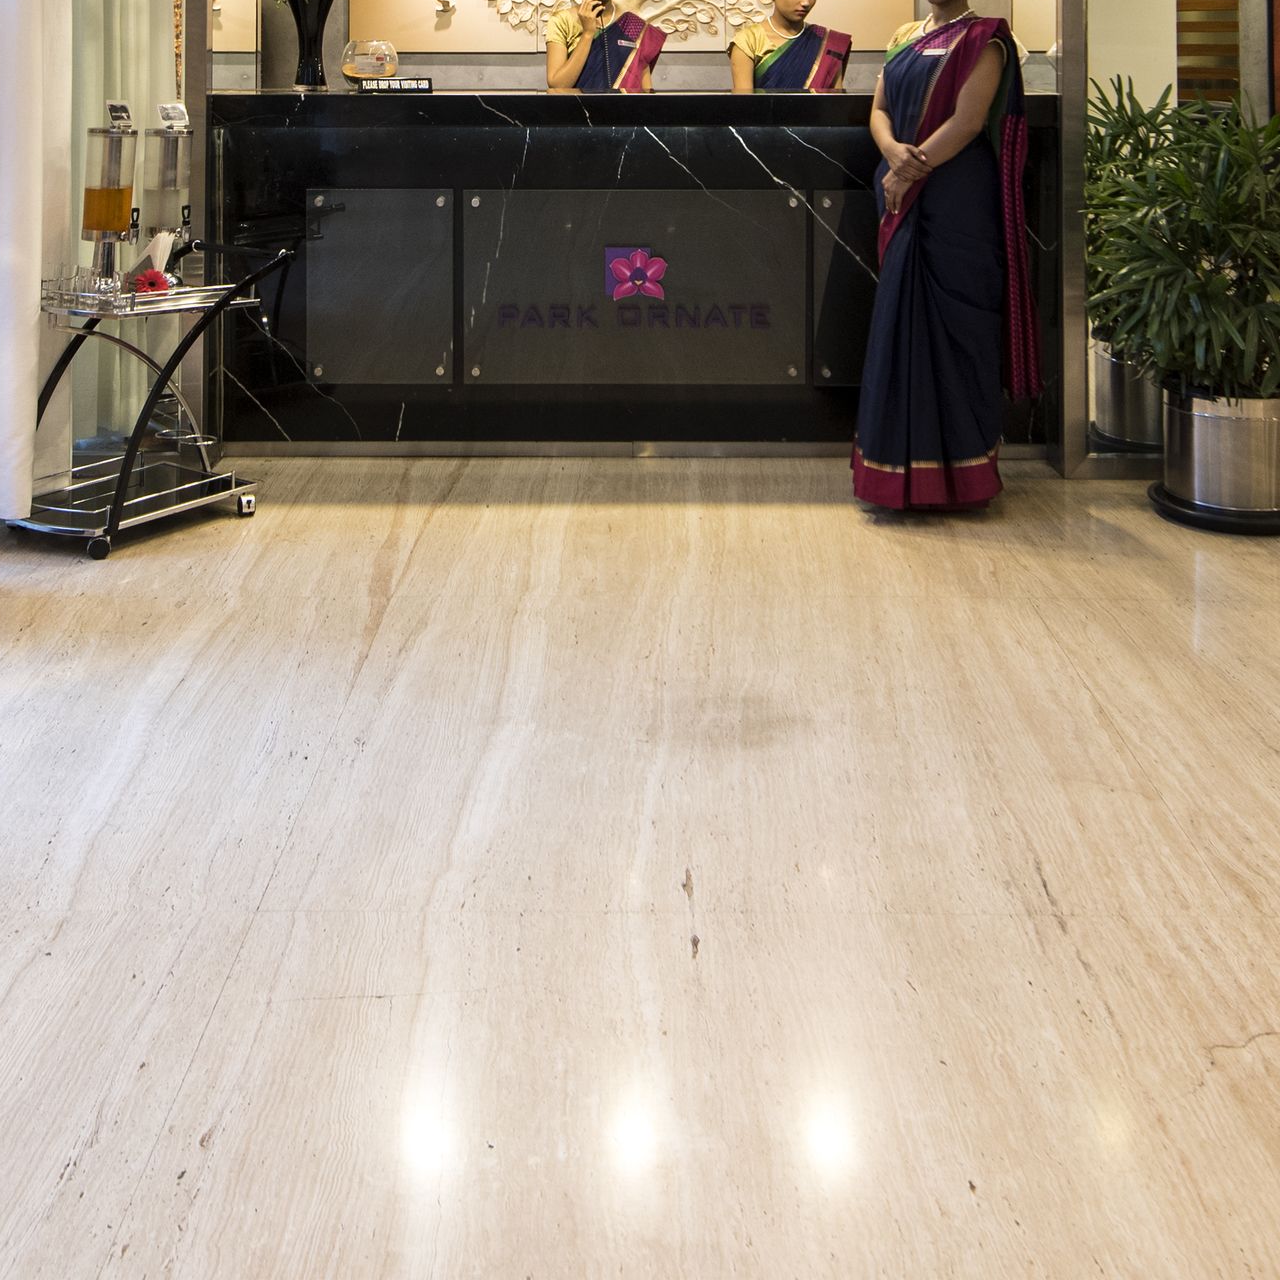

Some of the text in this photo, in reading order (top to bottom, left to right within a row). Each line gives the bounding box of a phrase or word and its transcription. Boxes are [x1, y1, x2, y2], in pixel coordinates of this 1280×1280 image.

[362, 79, 429, 89] PLEASE DROP YOUR VISITING CARD
[498, 303, 771, 329] PARK ORNATE
